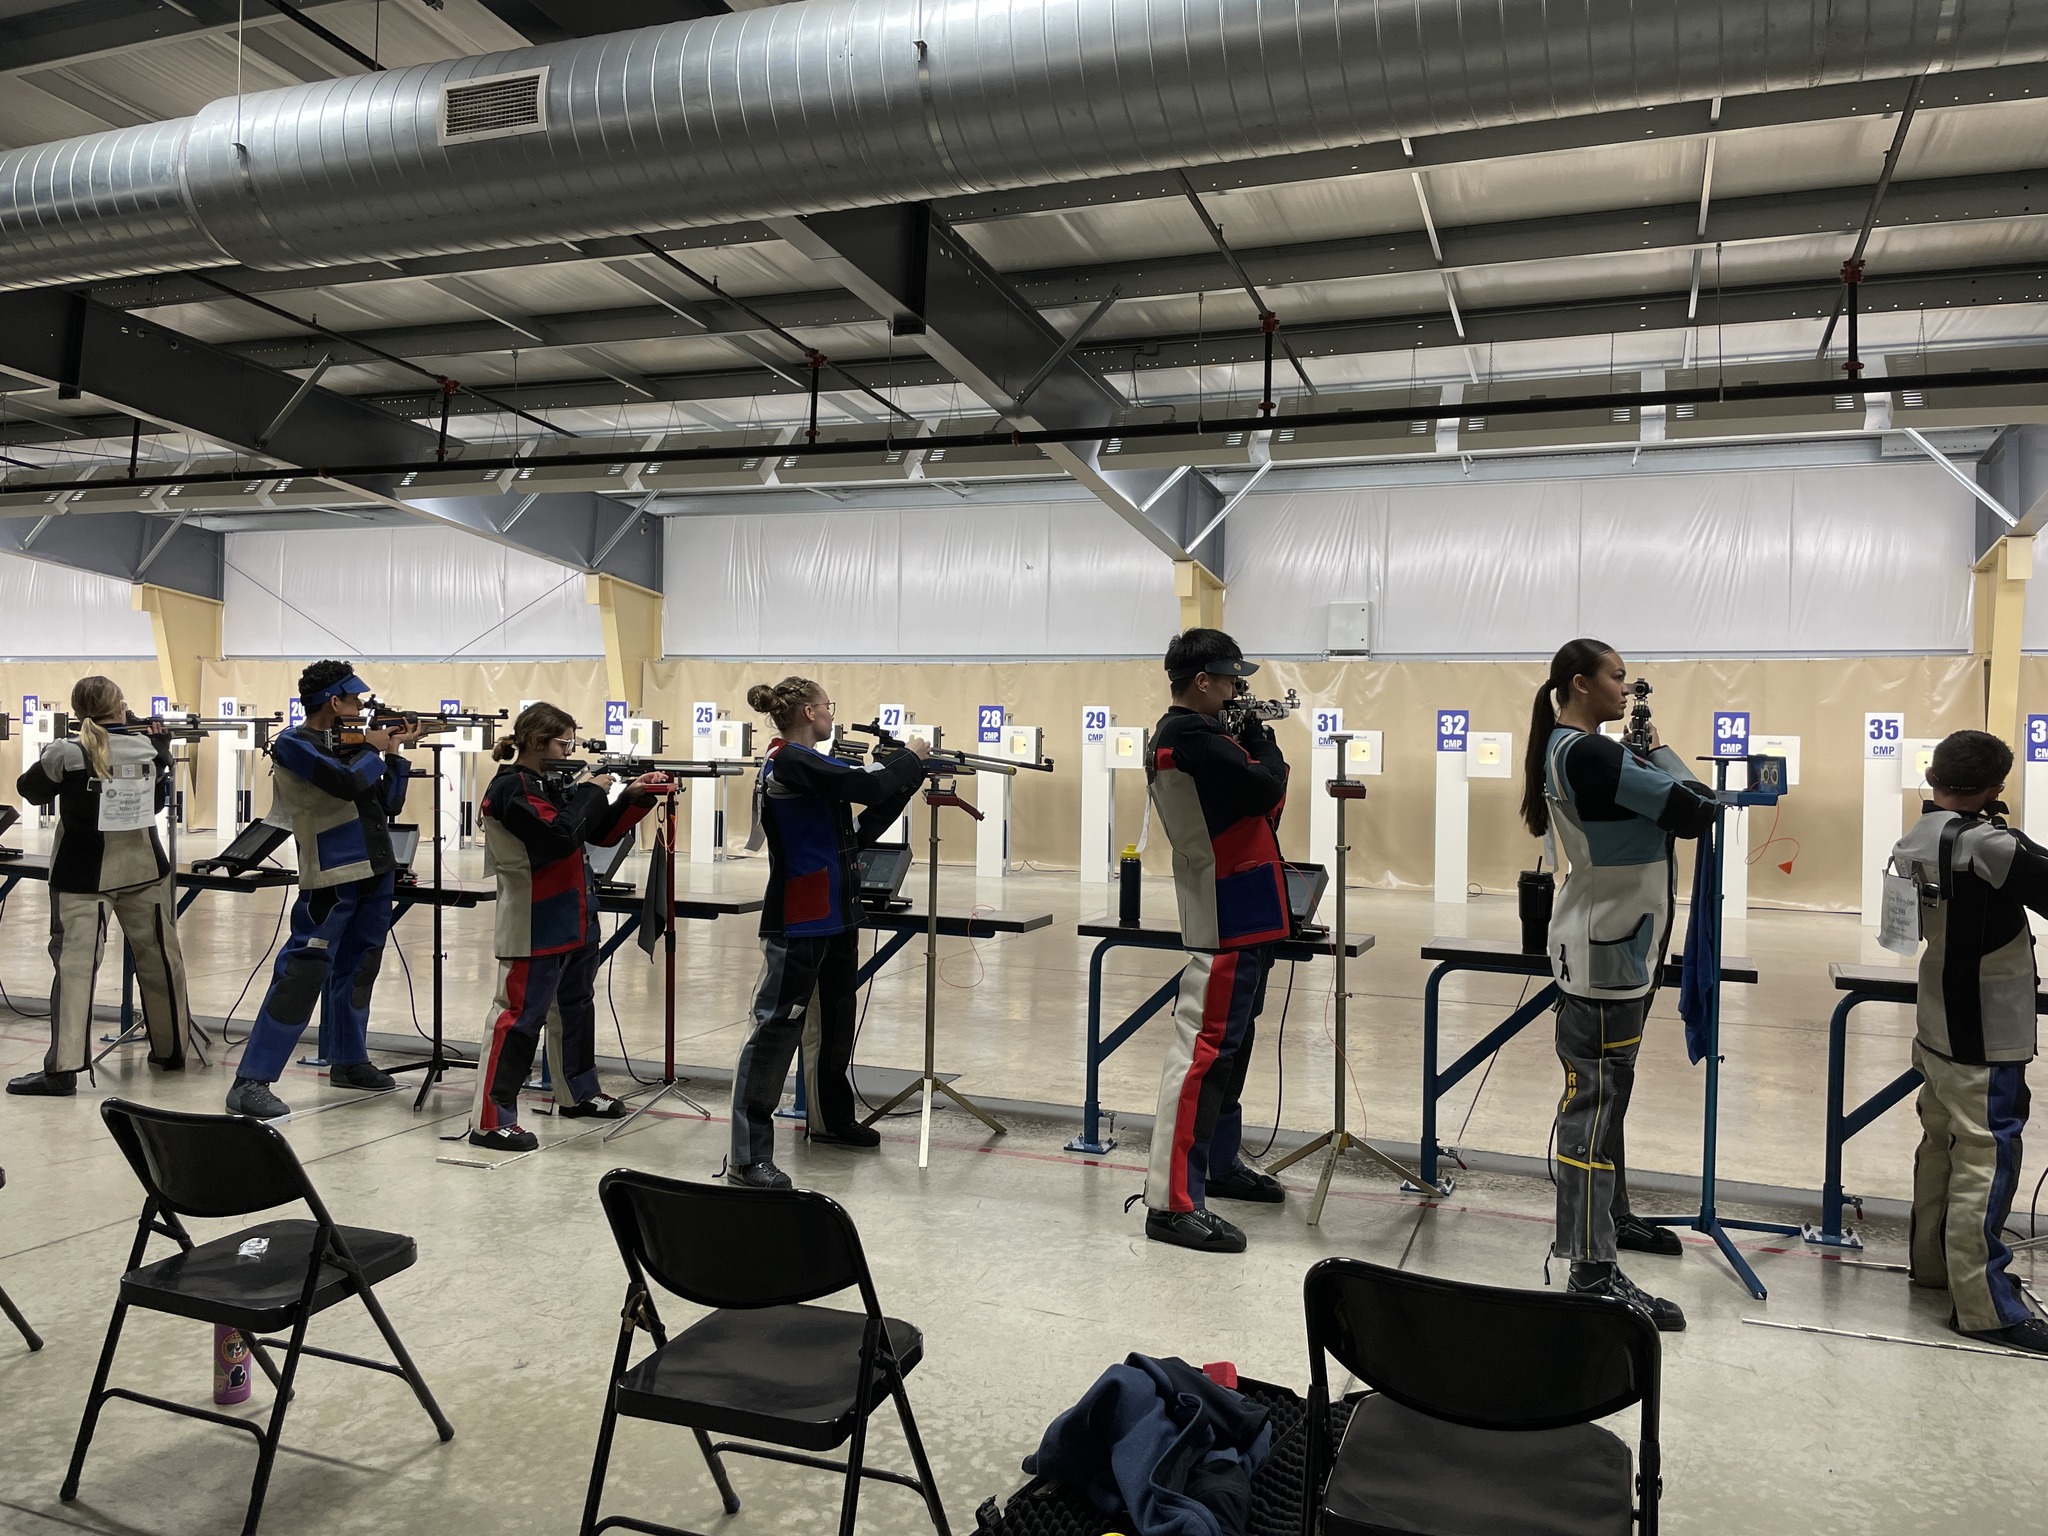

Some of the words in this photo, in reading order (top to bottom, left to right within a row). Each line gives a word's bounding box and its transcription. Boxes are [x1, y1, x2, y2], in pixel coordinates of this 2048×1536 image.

[25, 699, 37, 713] 16
[154, 700, 166, 715] 18
[222, 702, 233, 716] 19
[291, 702, 306, 717] 20
[608, 705, 624, 722] 24
[696, 707, 713, 723] 25
[884, 709, 900, 725] 27
[981, 710, 1001, 728] 28
[1086, 712, 1106, 729] 29
[1317, 713, 1337, 732] 31
[609, 725, 623, 734] CMP
[697, 727, 711, 735] CMP
[1440, 715, 1466, 735] 32
[1717, 717, 1746, 739] 34
[1869, 719, 1899, 740] 35
[2031, 720, 2047, 743] 3
[983, 732, 998, 741] CMP
[1088, 734, 1103, 742] CMP
[1318, 737, 1336, 746] CMP
[1443, 739, 1462, 749] CMP
[1720, 743, 1742, 754] CMP
[1872, 746, 1895, 756] CMP
[2034, 748, 2048, 759] CM
